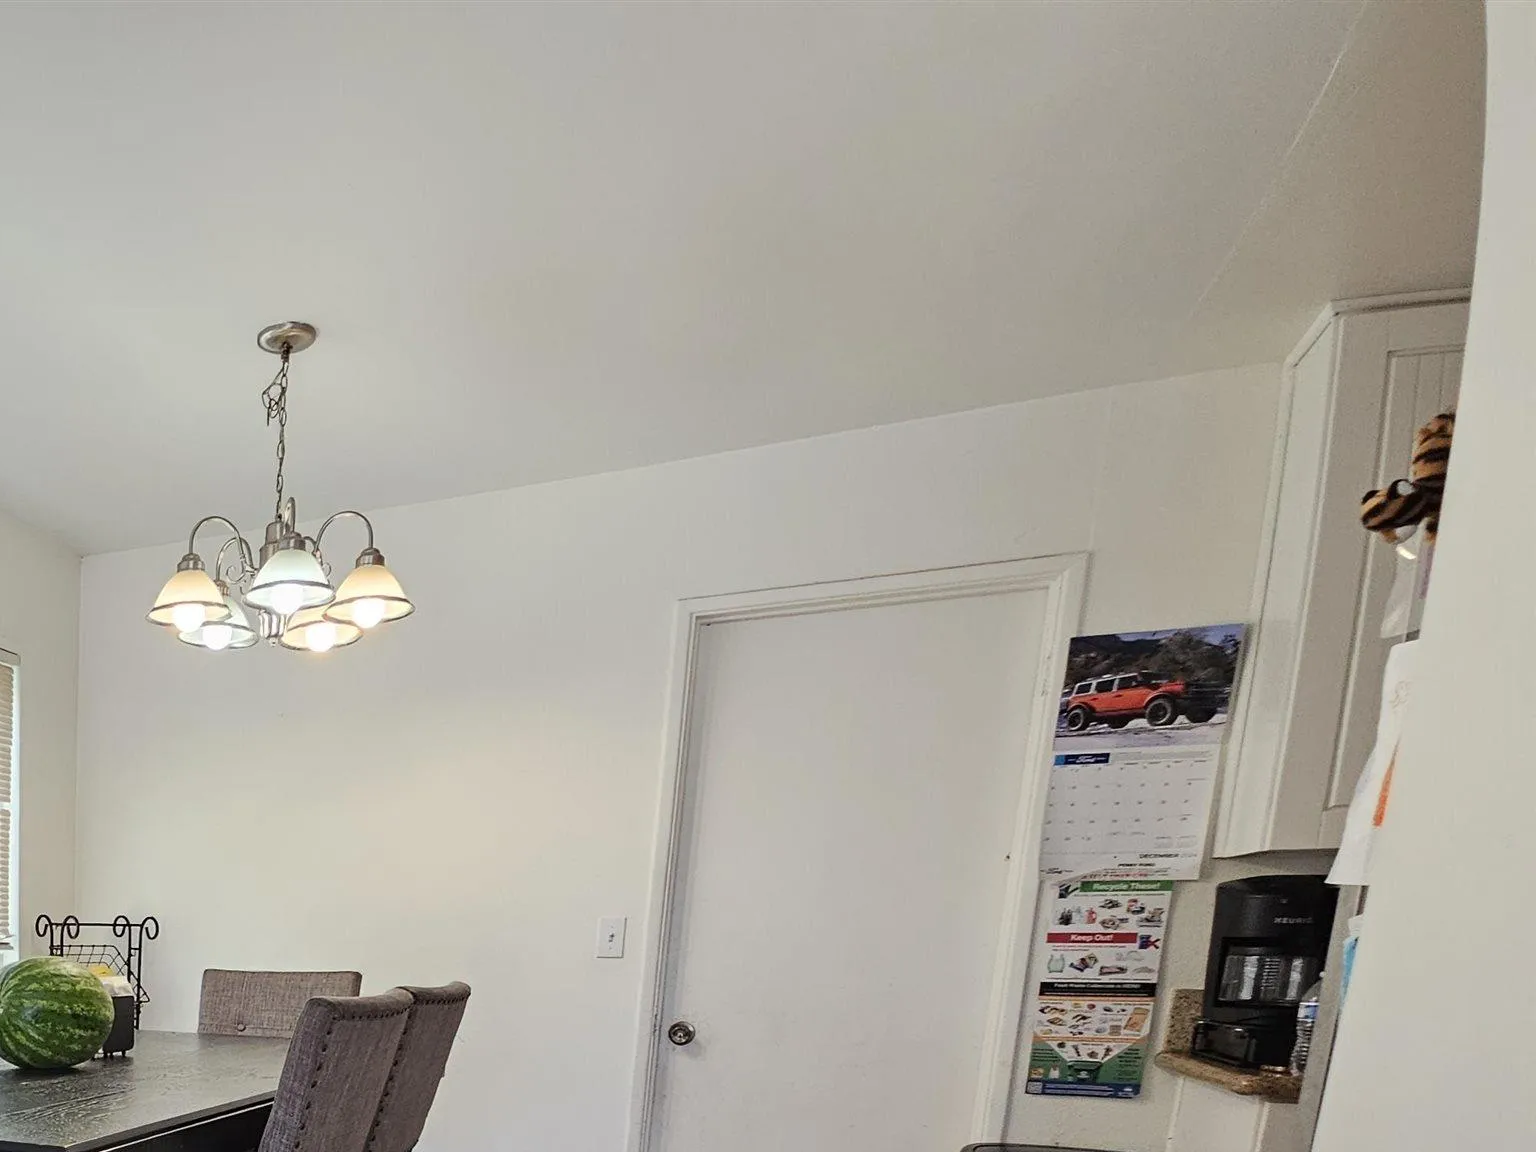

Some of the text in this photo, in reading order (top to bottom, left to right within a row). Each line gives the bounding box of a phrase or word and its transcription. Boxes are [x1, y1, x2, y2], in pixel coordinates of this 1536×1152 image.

[1092, 882, 1161, 892] Recycle These!
[1070, 934, 1093, 942] Keep
